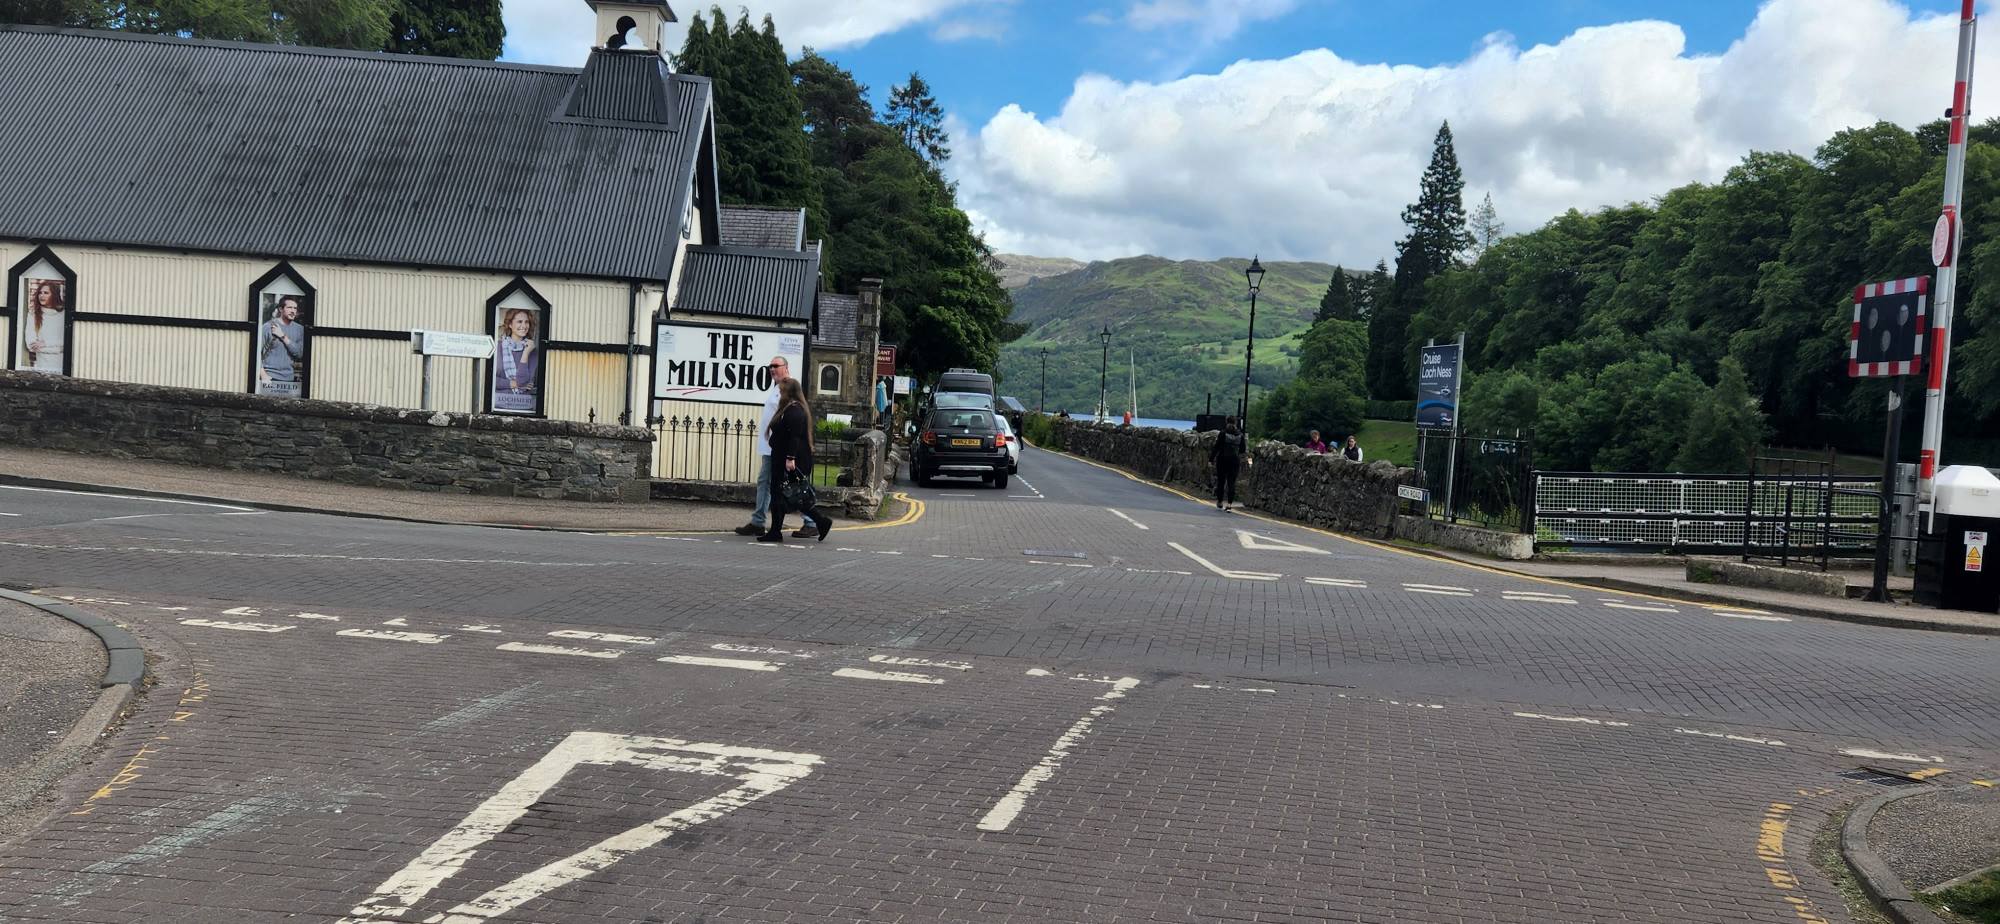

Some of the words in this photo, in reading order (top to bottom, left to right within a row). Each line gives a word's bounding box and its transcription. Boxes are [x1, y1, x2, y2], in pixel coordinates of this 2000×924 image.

[707, 332, 754, 361] THE
[1422, 352, 1441, 365] Cruise
[667, 359, 772, 391] MILLSHO
[1421, 366, 1436, 379] Loch
[1437, 366, 1452, 378] Ness
[1410, 490, 1421, 499] ROAD
